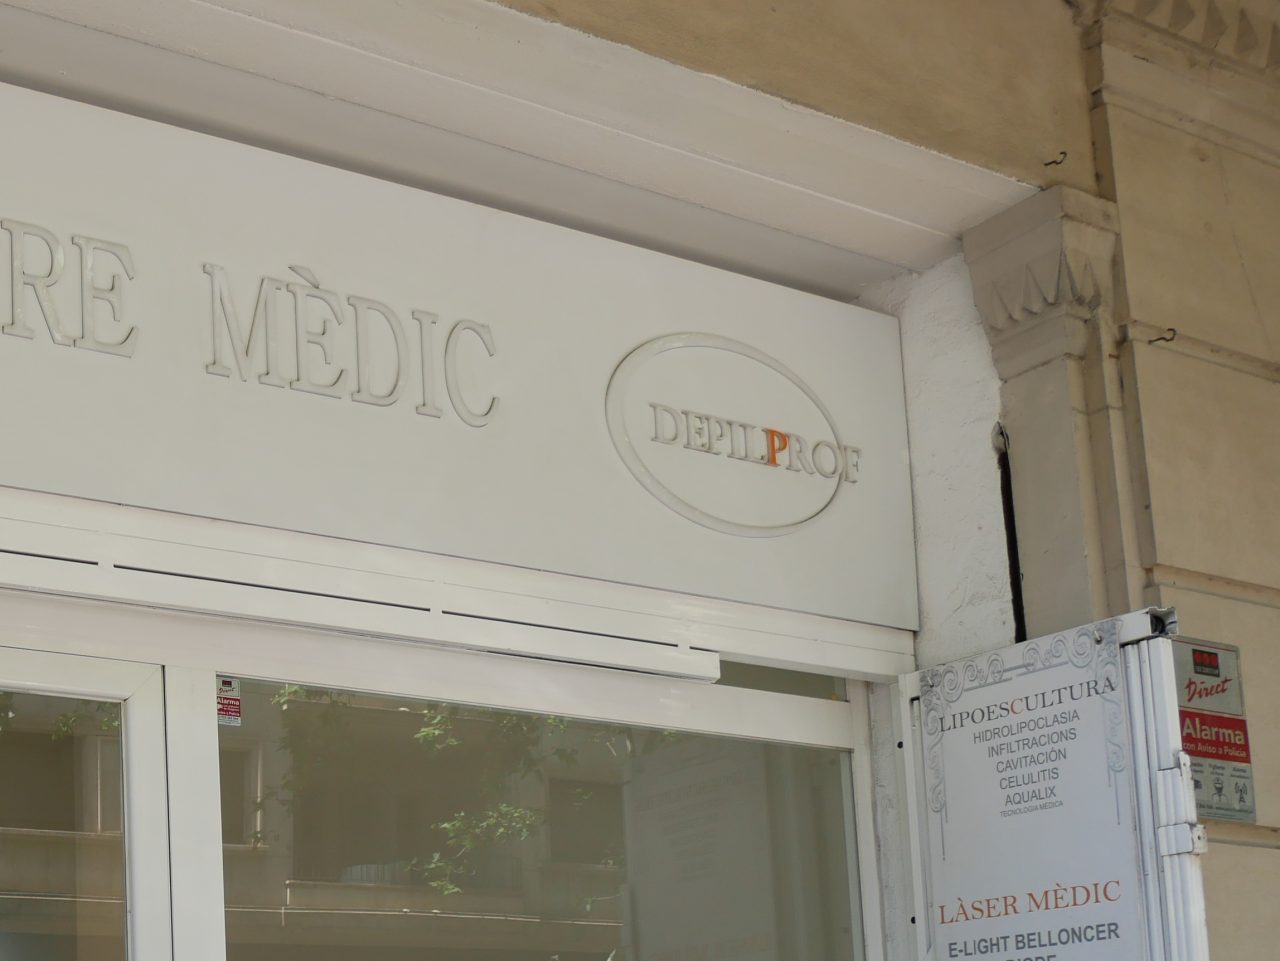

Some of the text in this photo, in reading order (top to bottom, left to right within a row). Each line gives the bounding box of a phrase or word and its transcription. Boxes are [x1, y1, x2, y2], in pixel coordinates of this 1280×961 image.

[202, 263, 499, 428] MÈDIC
[648, 402, 862, 483] DEPILPROF
[939, 676, 1118, 732] LIPOESCULTURA
[1184, 677, 1233, 702] Direct
[972, 709, 1081, 744] HIDROLIPOCLASIA
[1182, 717, 1246, 745] Alarma
[987, 728, 1078, 758] INFILTRACIONS
[1197, 743, 1217, 754] Aviso
[996, 747, 1067, 773] CAVITACIÓN
[999, 767, 1060, 790] CELULITIS
[1005, 786, 1057, 807] AQUALIX
[939, 879, 1122, 925] LÀSER MÈDIC
[948, 922, 1120, 958] E-LIGHT BELLONCER
